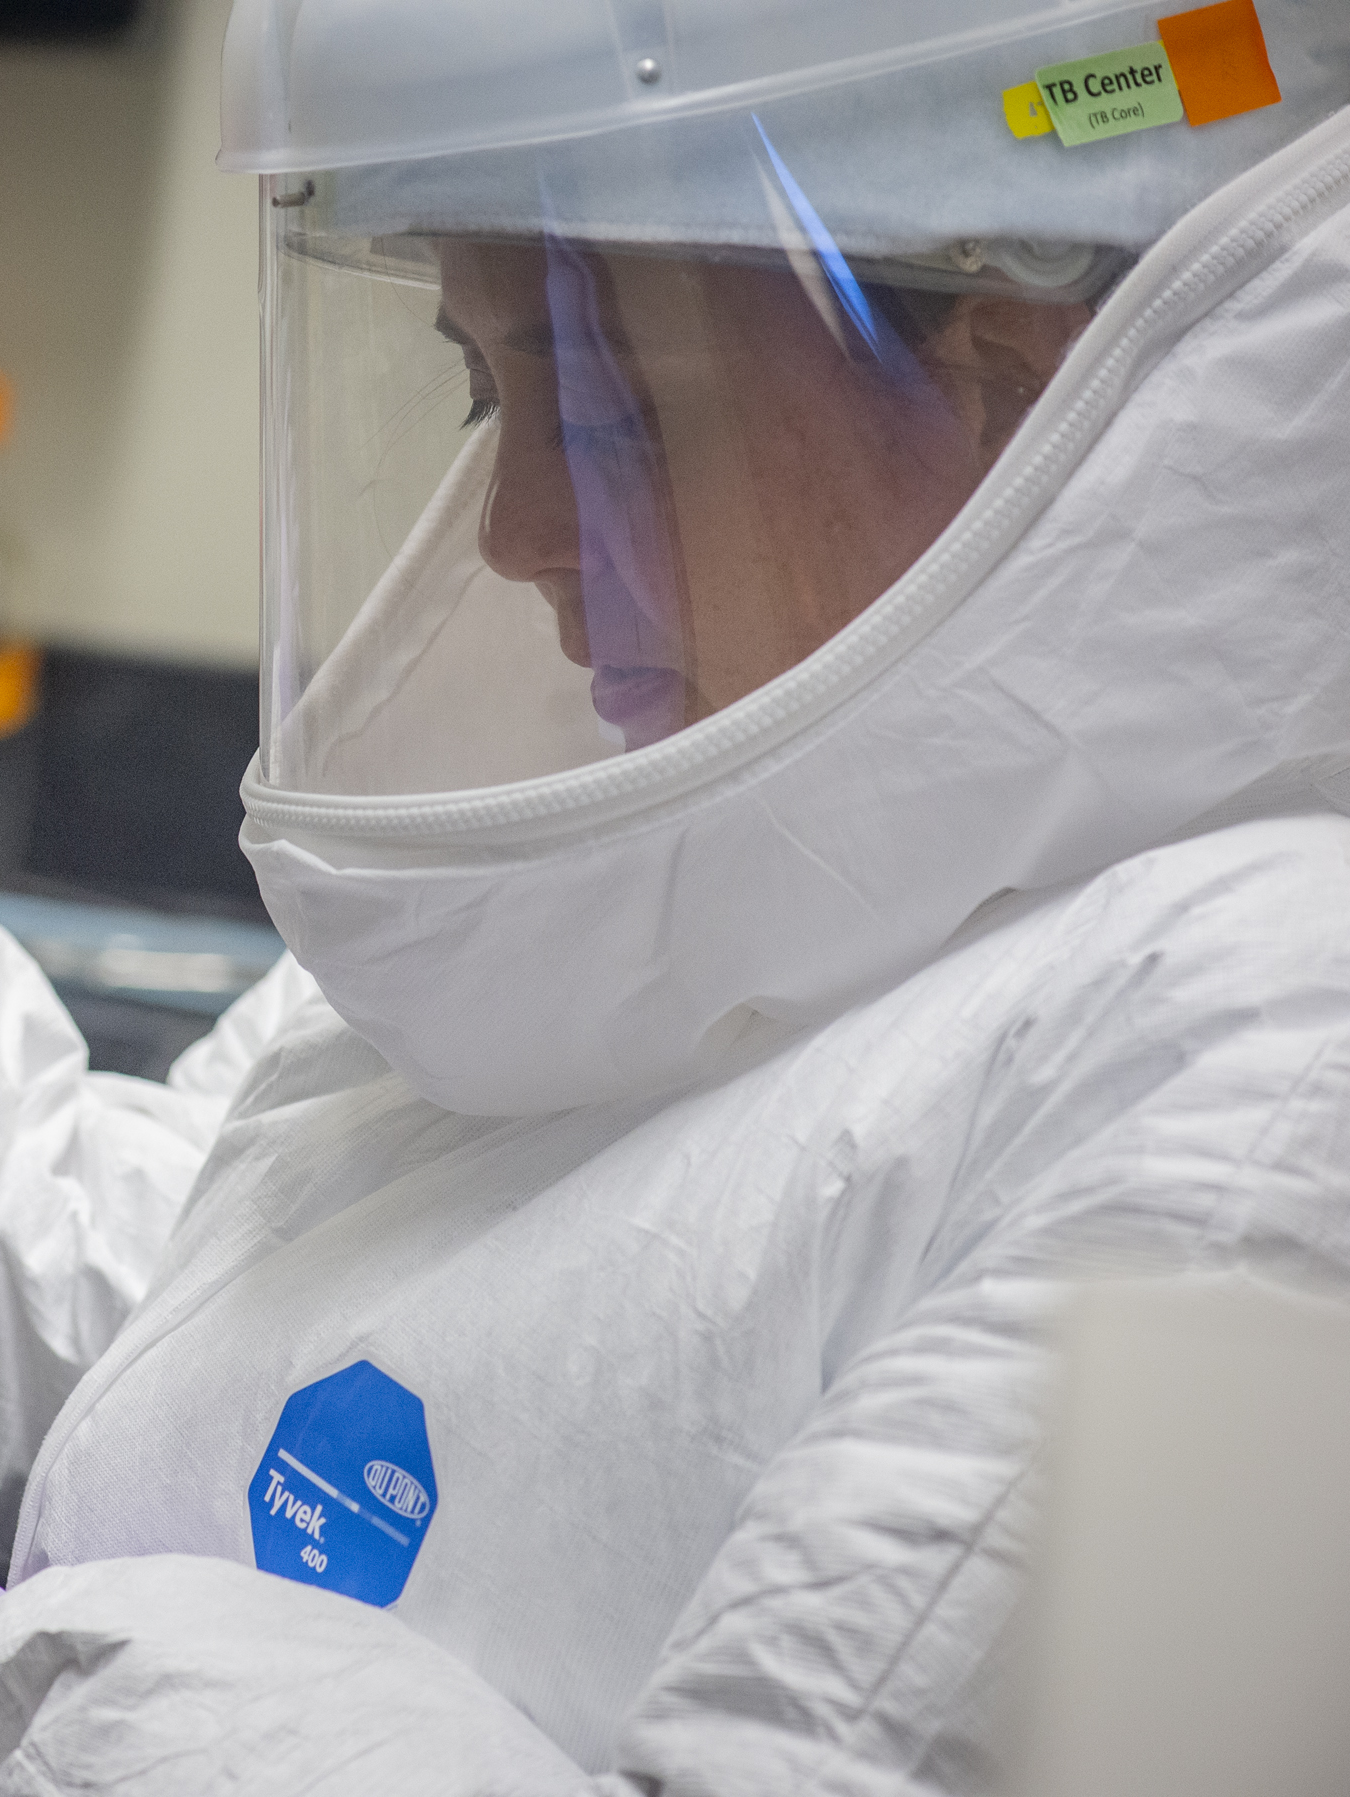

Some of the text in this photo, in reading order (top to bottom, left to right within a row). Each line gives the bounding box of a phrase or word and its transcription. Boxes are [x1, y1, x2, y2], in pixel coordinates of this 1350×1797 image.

[1044, 62, 1164, 106] TB Center
[1088, 102, 1146, 129] (TB Core)
[263, 1467, 327, 1542] Tyvek
[300, 1544, 328, 1573] 400
